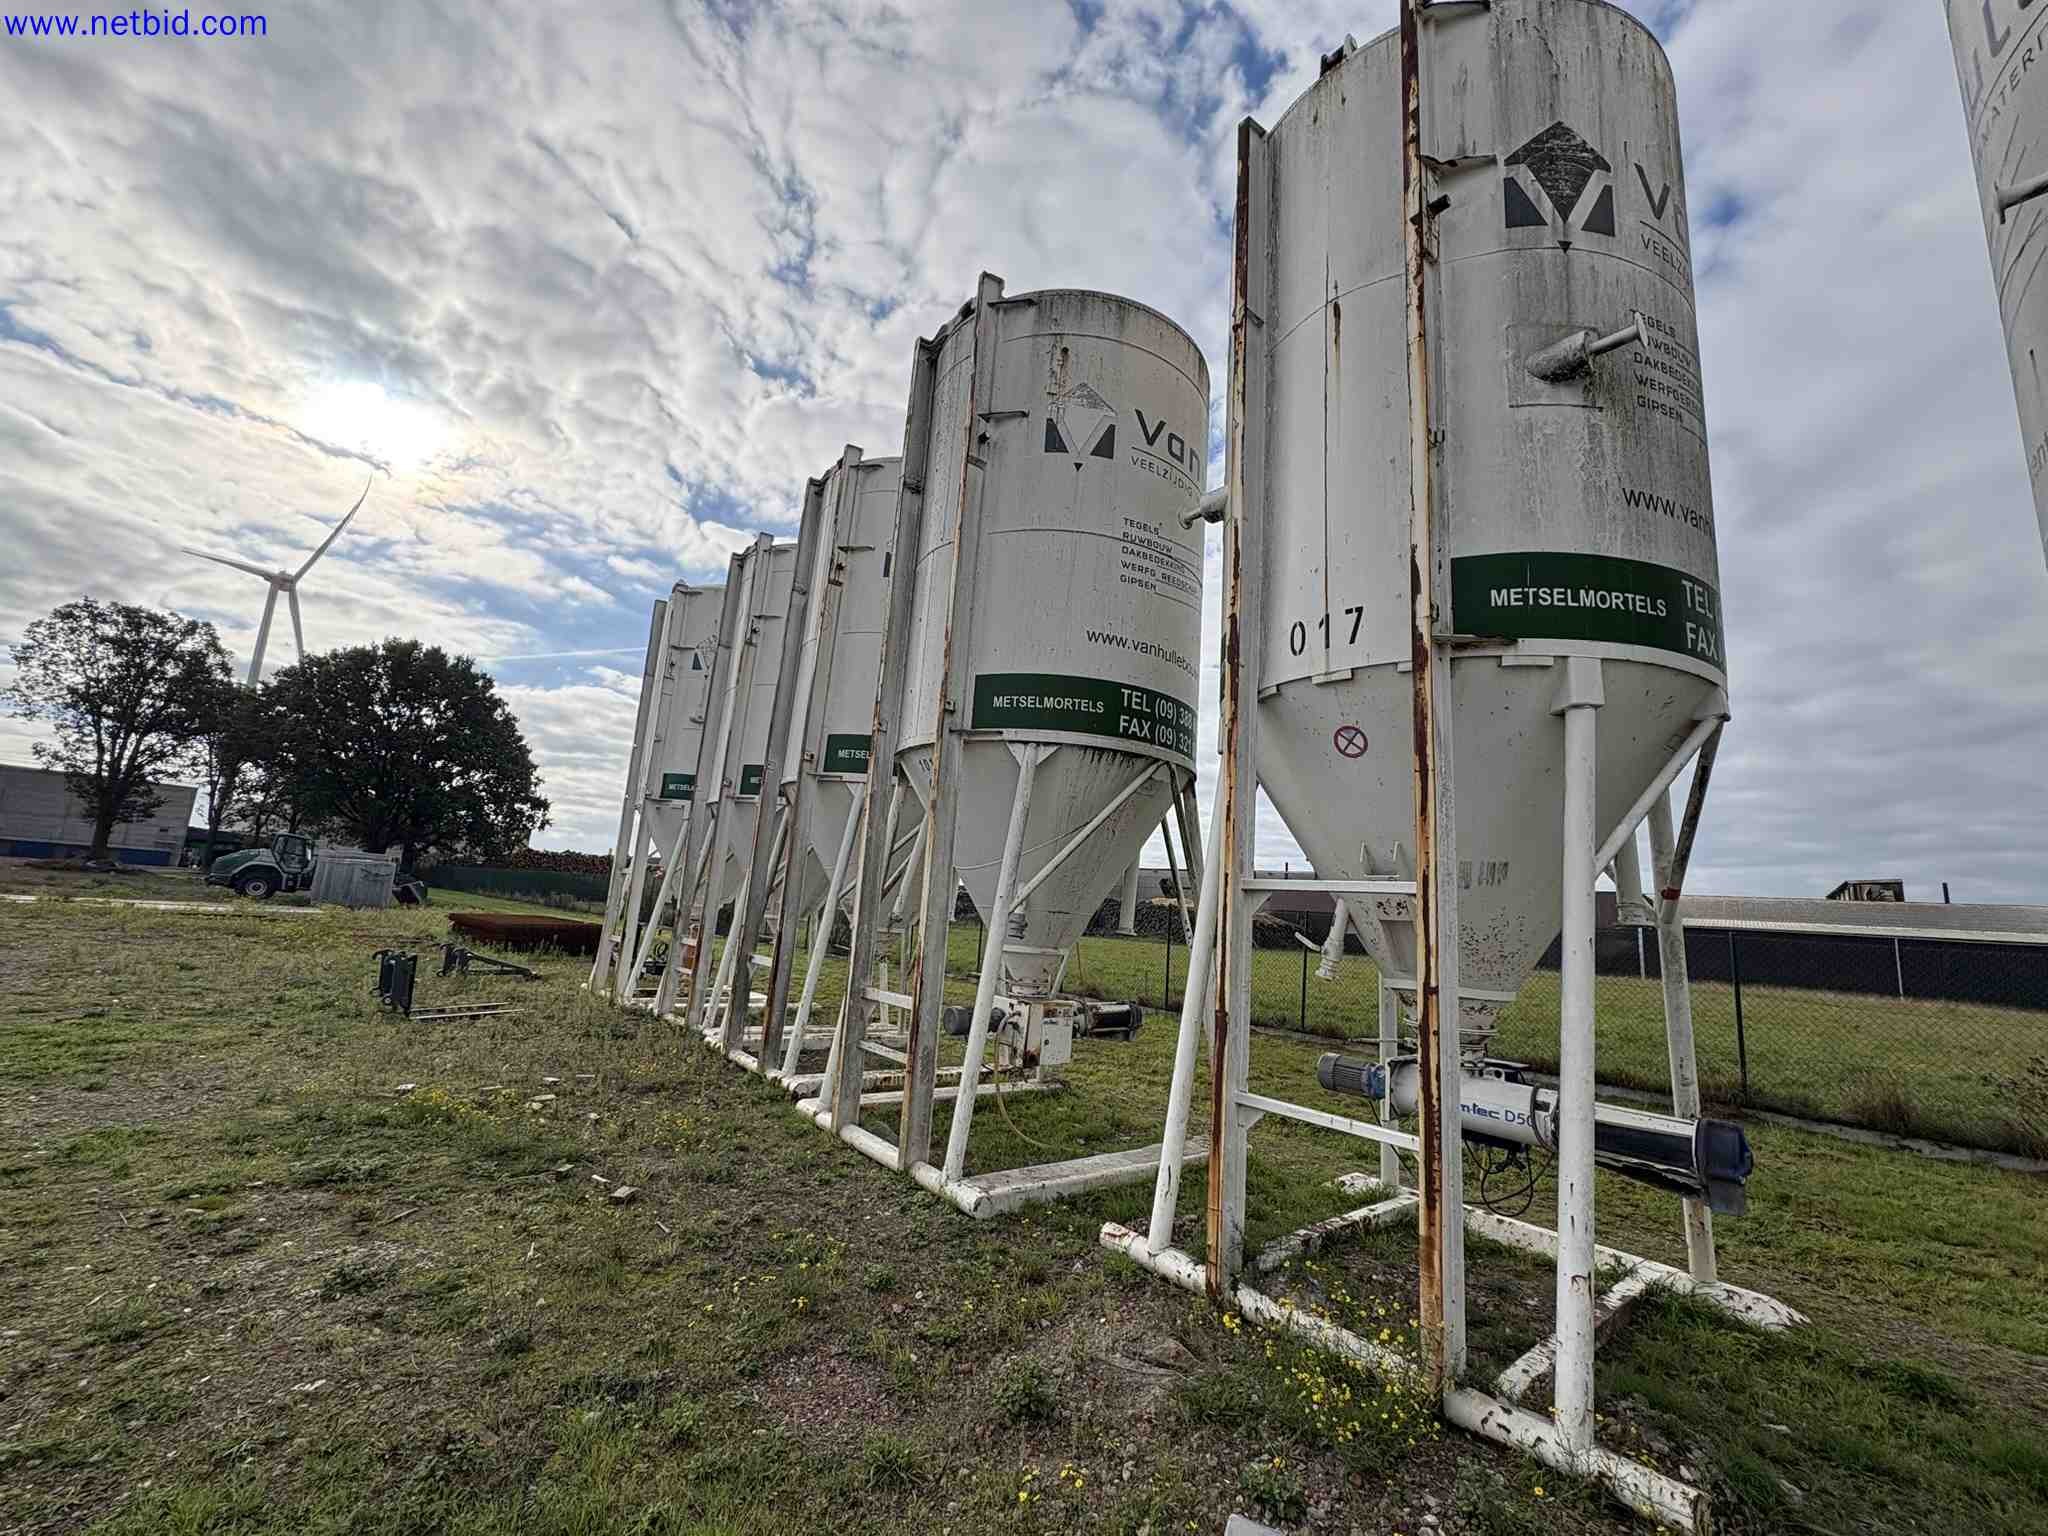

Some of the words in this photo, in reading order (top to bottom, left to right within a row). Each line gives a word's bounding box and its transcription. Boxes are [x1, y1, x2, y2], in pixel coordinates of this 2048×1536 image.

[1122, 516, 1160, 536] TEGELS
[1490, 587, 1668, 618] METSELMORTELS
[1682, 578, 1715, 619] TEL
[1684, 620, 1721, 662] FAX
[992, 694, 1105, 714] METSELMORTELS
[1121, 688, 1152, 713] TEL
[1155, 697, 1177, 726] (09)
[1119, 715, 1152, 740] FAX
[1154, 722, 1177, 751] (09)
